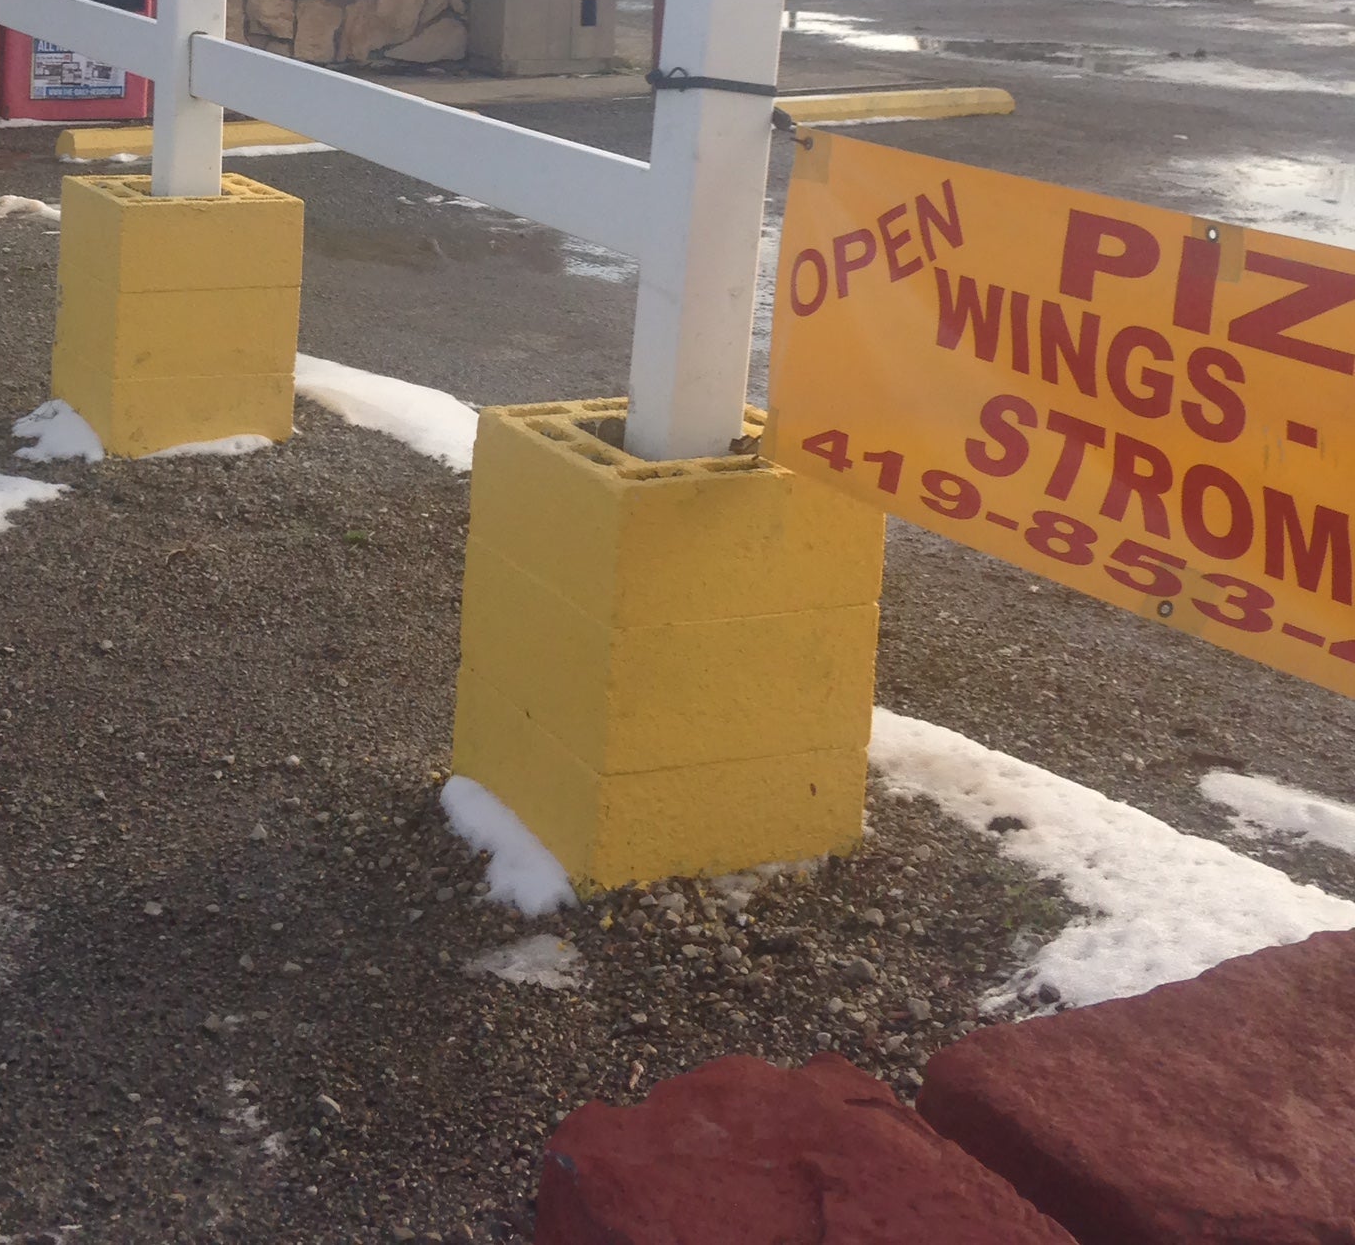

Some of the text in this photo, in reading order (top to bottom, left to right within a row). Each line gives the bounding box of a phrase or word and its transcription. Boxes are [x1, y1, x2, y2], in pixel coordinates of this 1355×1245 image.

[791, 179, 964, 317] OPEN
[1059, 208, 1355, 375] PIZ
[934, 267, 1248, 444] WINGS
[965, 393, 1353, 605] STROM
